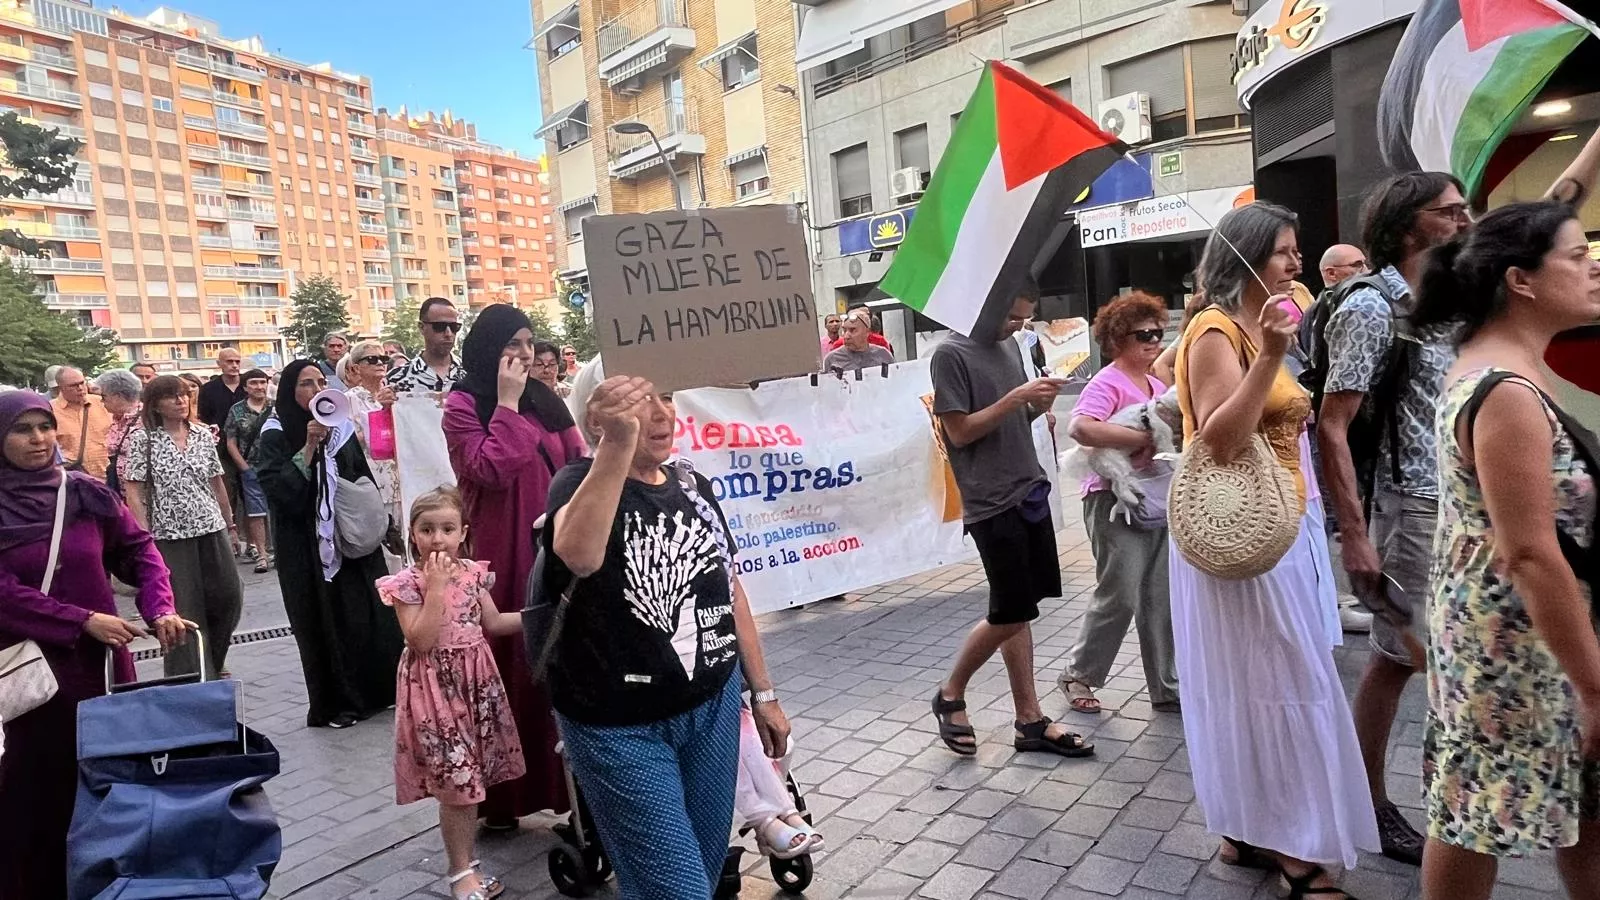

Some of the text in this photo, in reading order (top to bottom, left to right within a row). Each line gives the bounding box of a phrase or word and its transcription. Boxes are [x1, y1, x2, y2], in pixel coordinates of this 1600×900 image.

[1129, 199, 1186, 217] Frutos Secos
[615, 217, 724, 257] GAZA
[1082, 226, 1117, 244] Pan
[622, 248, 792, 295] MUERE DE
[613, 293, 811, 347] LA HAMBRUNA
[728, 450, 804, 472] lo que
[710, 461, 863, 502] ompras.
[728, 514, 743, 530] el
[735, 520, 841, 549] blo palestino.
[768, 554, 779, 568] a
[779, 547, 800, 565] la
